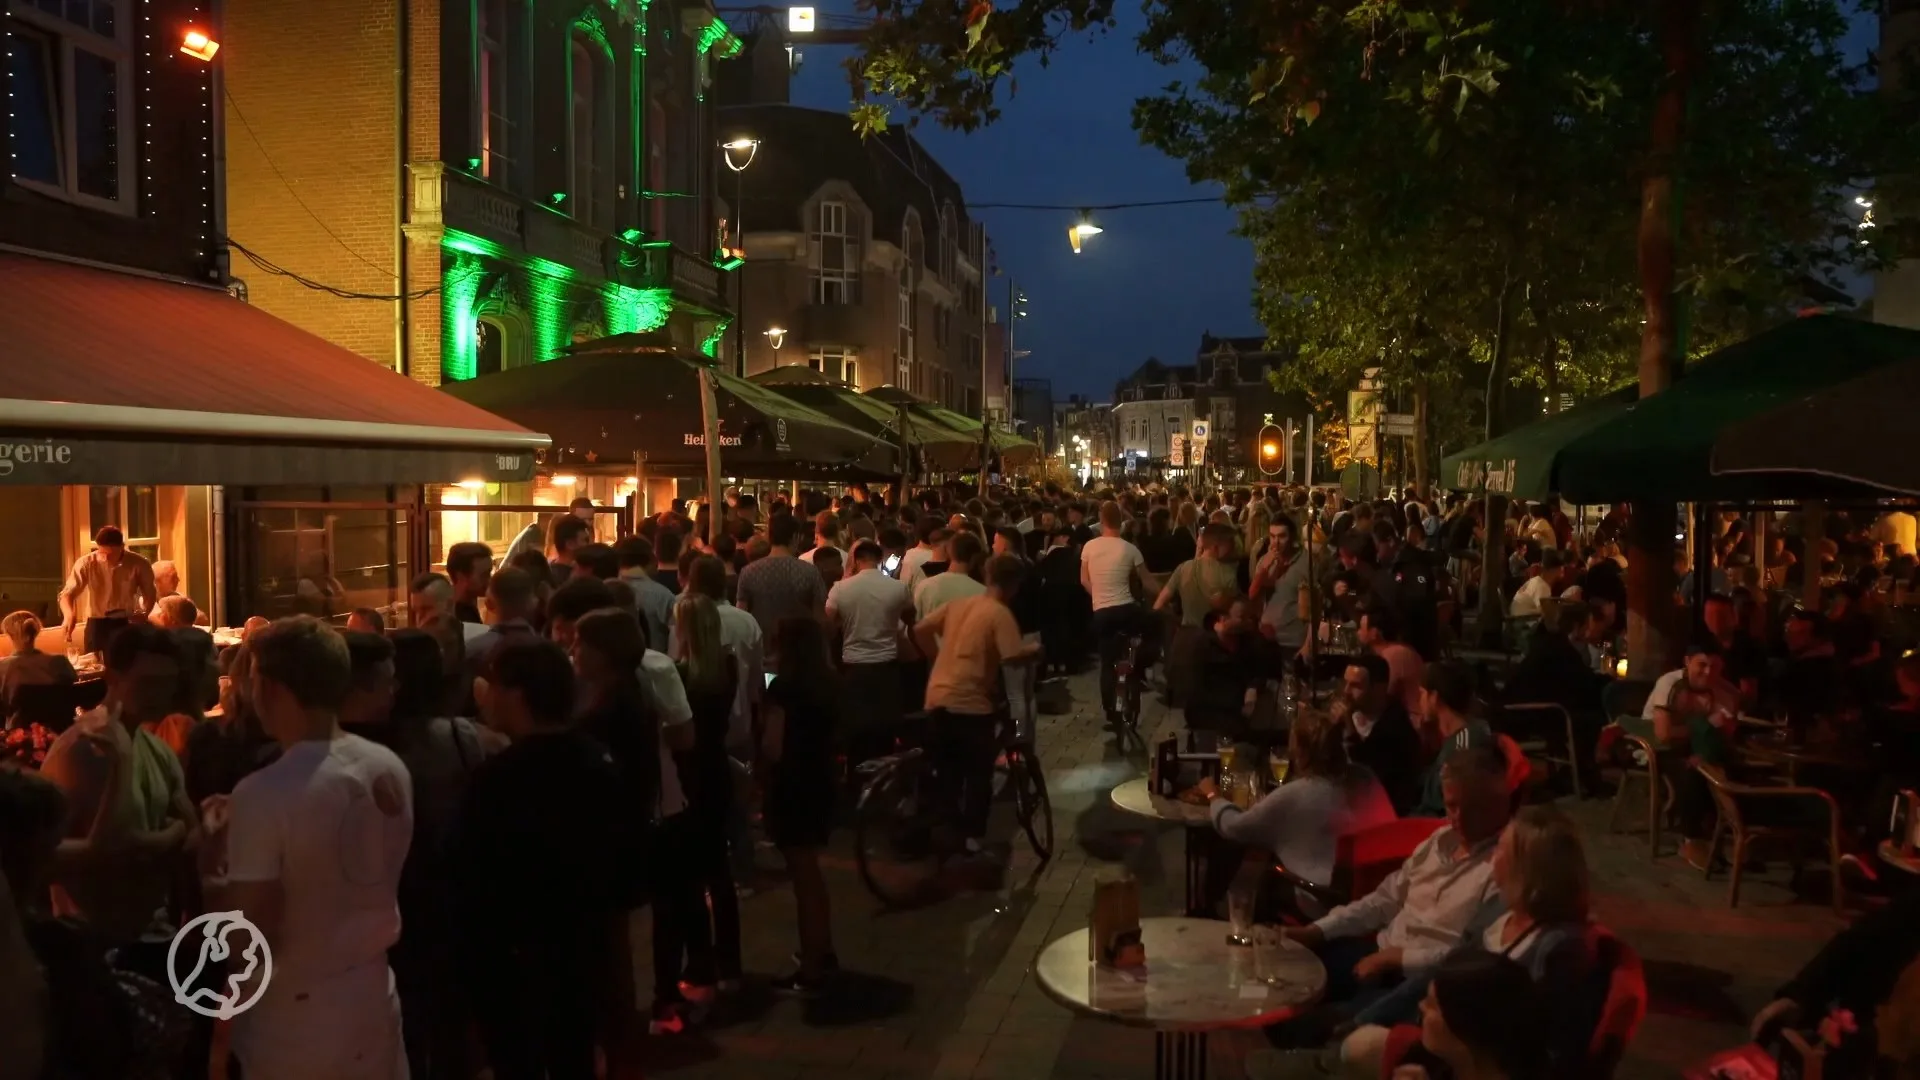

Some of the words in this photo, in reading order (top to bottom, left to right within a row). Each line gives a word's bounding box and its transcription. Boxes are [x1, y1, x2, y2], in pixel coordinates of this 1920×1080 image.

[684, 433, 742, 446] Heiken
[0, 438, 71, 476] gerie
[498, 455, 520, 470] BRU
